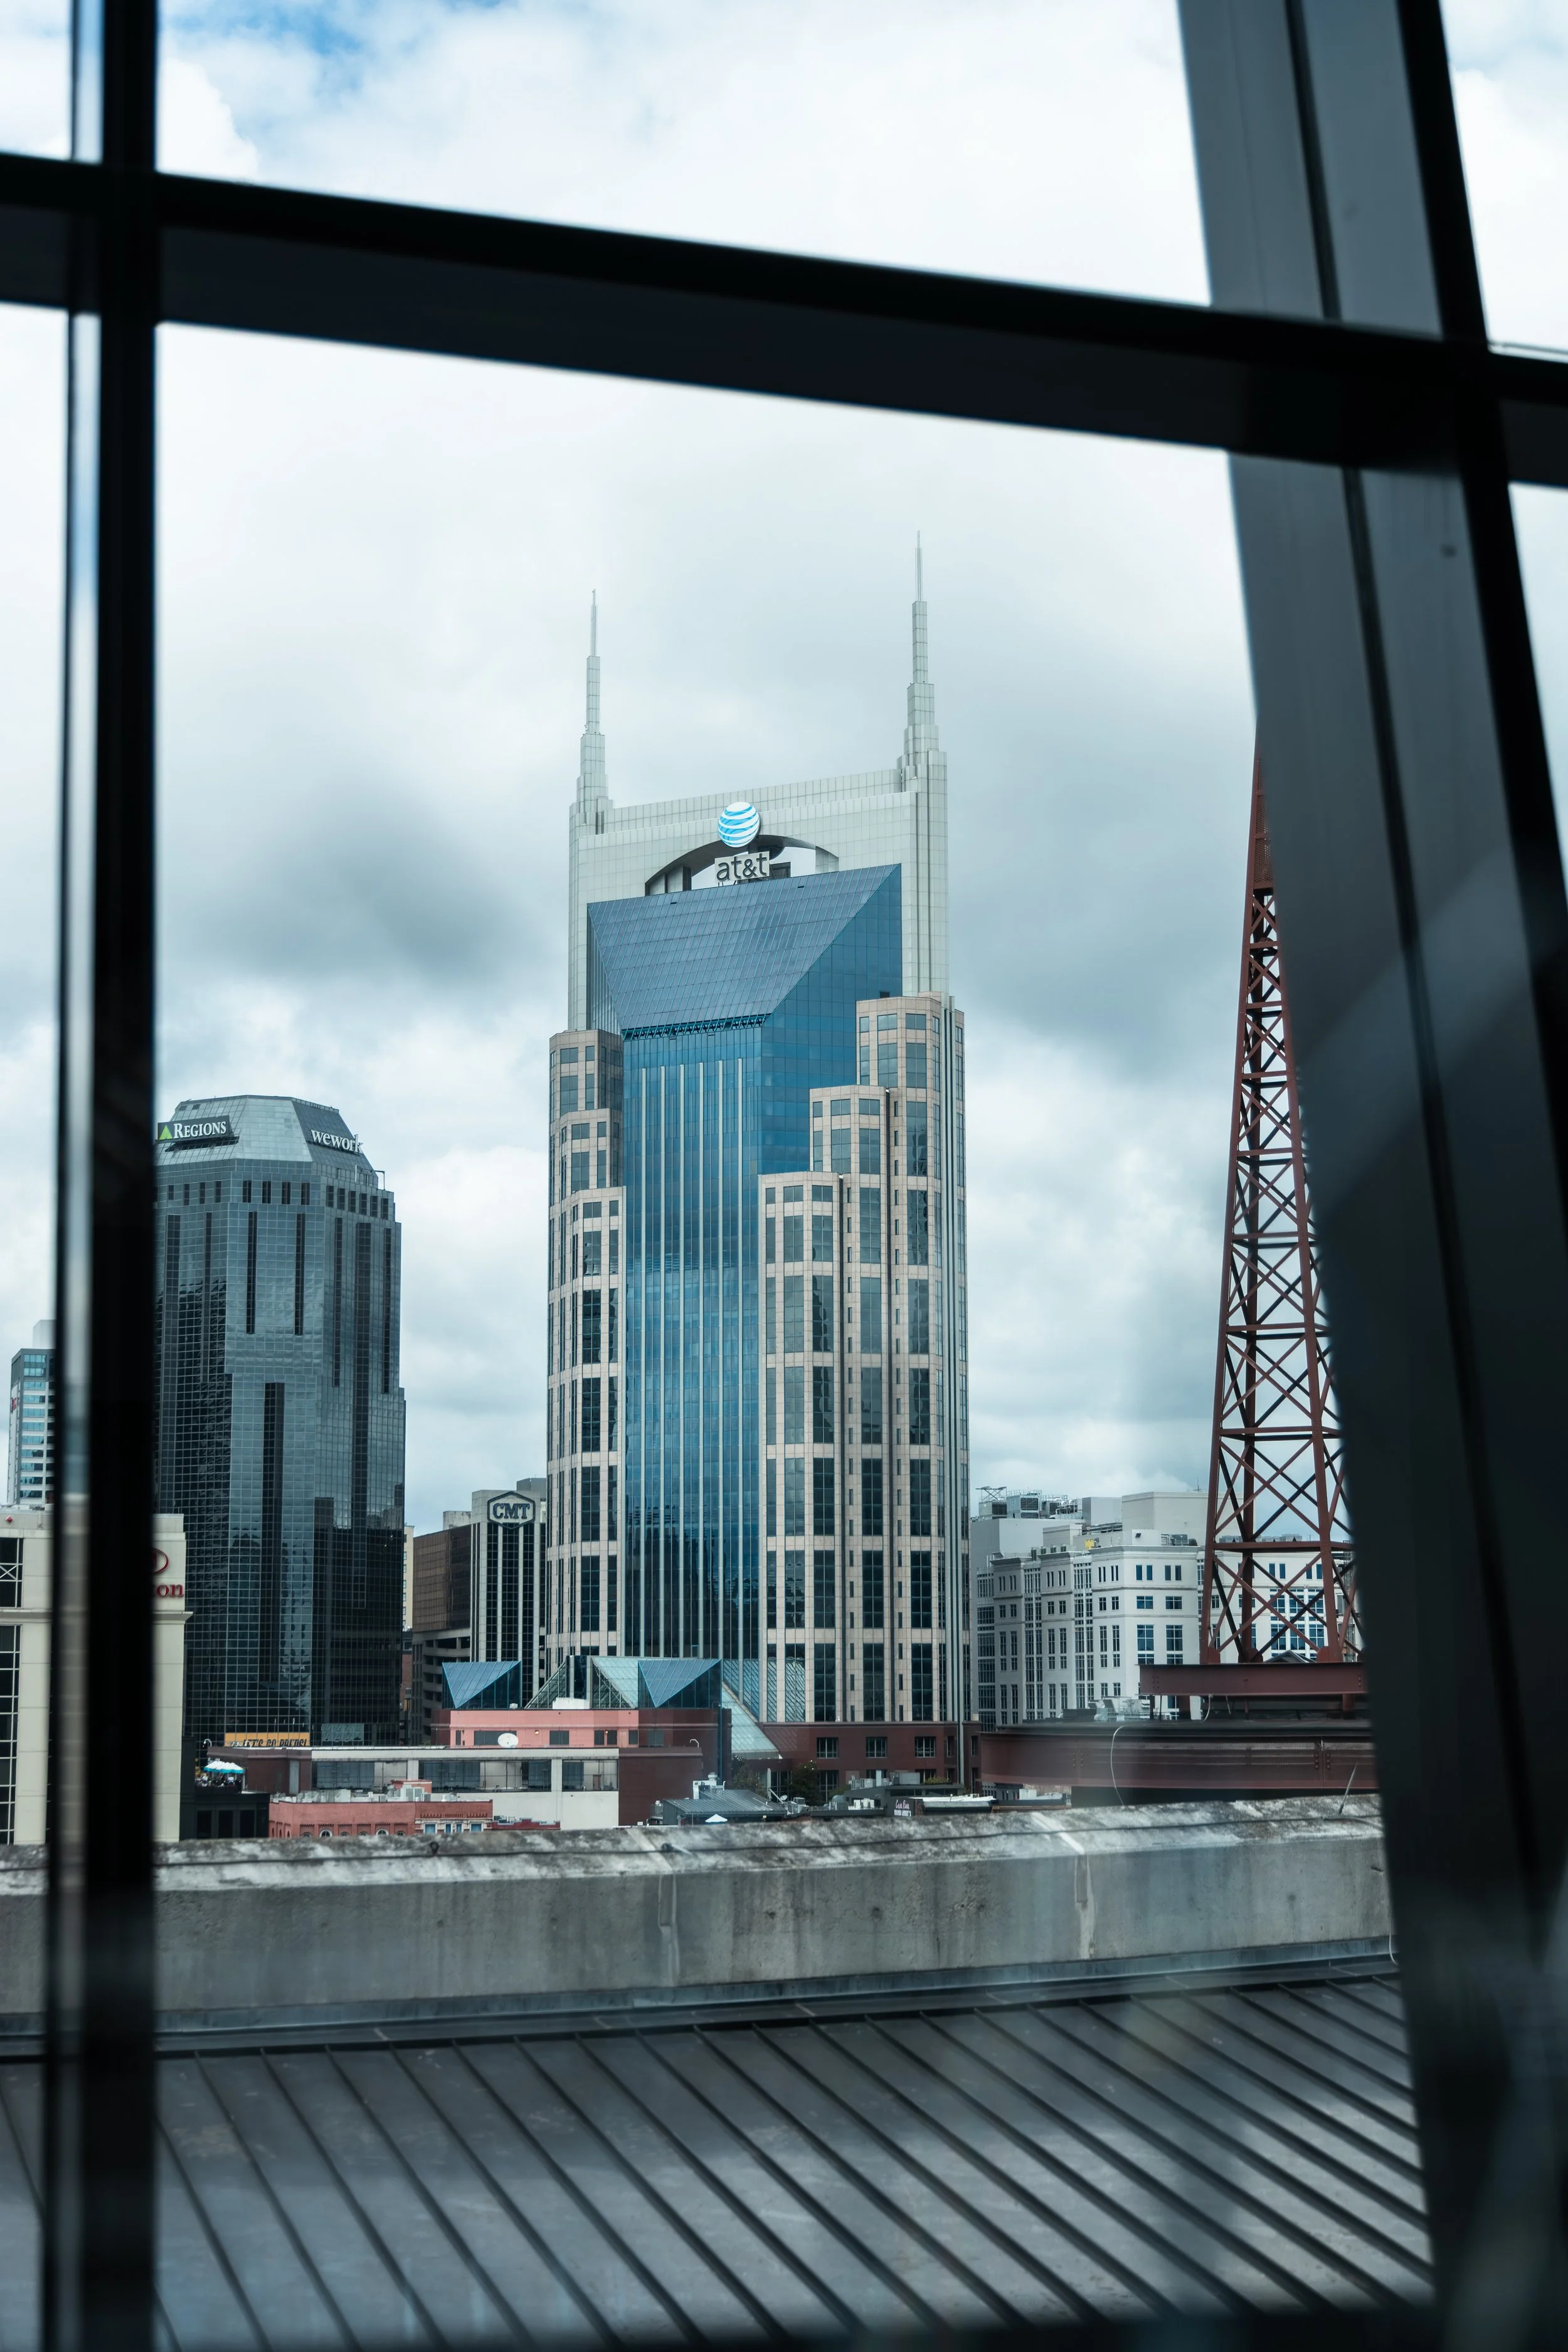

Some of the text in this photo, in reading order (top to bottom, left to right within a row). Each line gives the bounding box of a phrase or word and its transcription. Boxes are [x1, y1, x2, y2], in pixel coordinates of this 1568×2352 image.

[716, 853, 767, 881] at&t
[174, 1121, 226, 1139] REGIONS
[311, 1130, 364, 1153] wework
[493, 1503, 530, 1519] CMT
[156, 1584, 184, 1598] on
